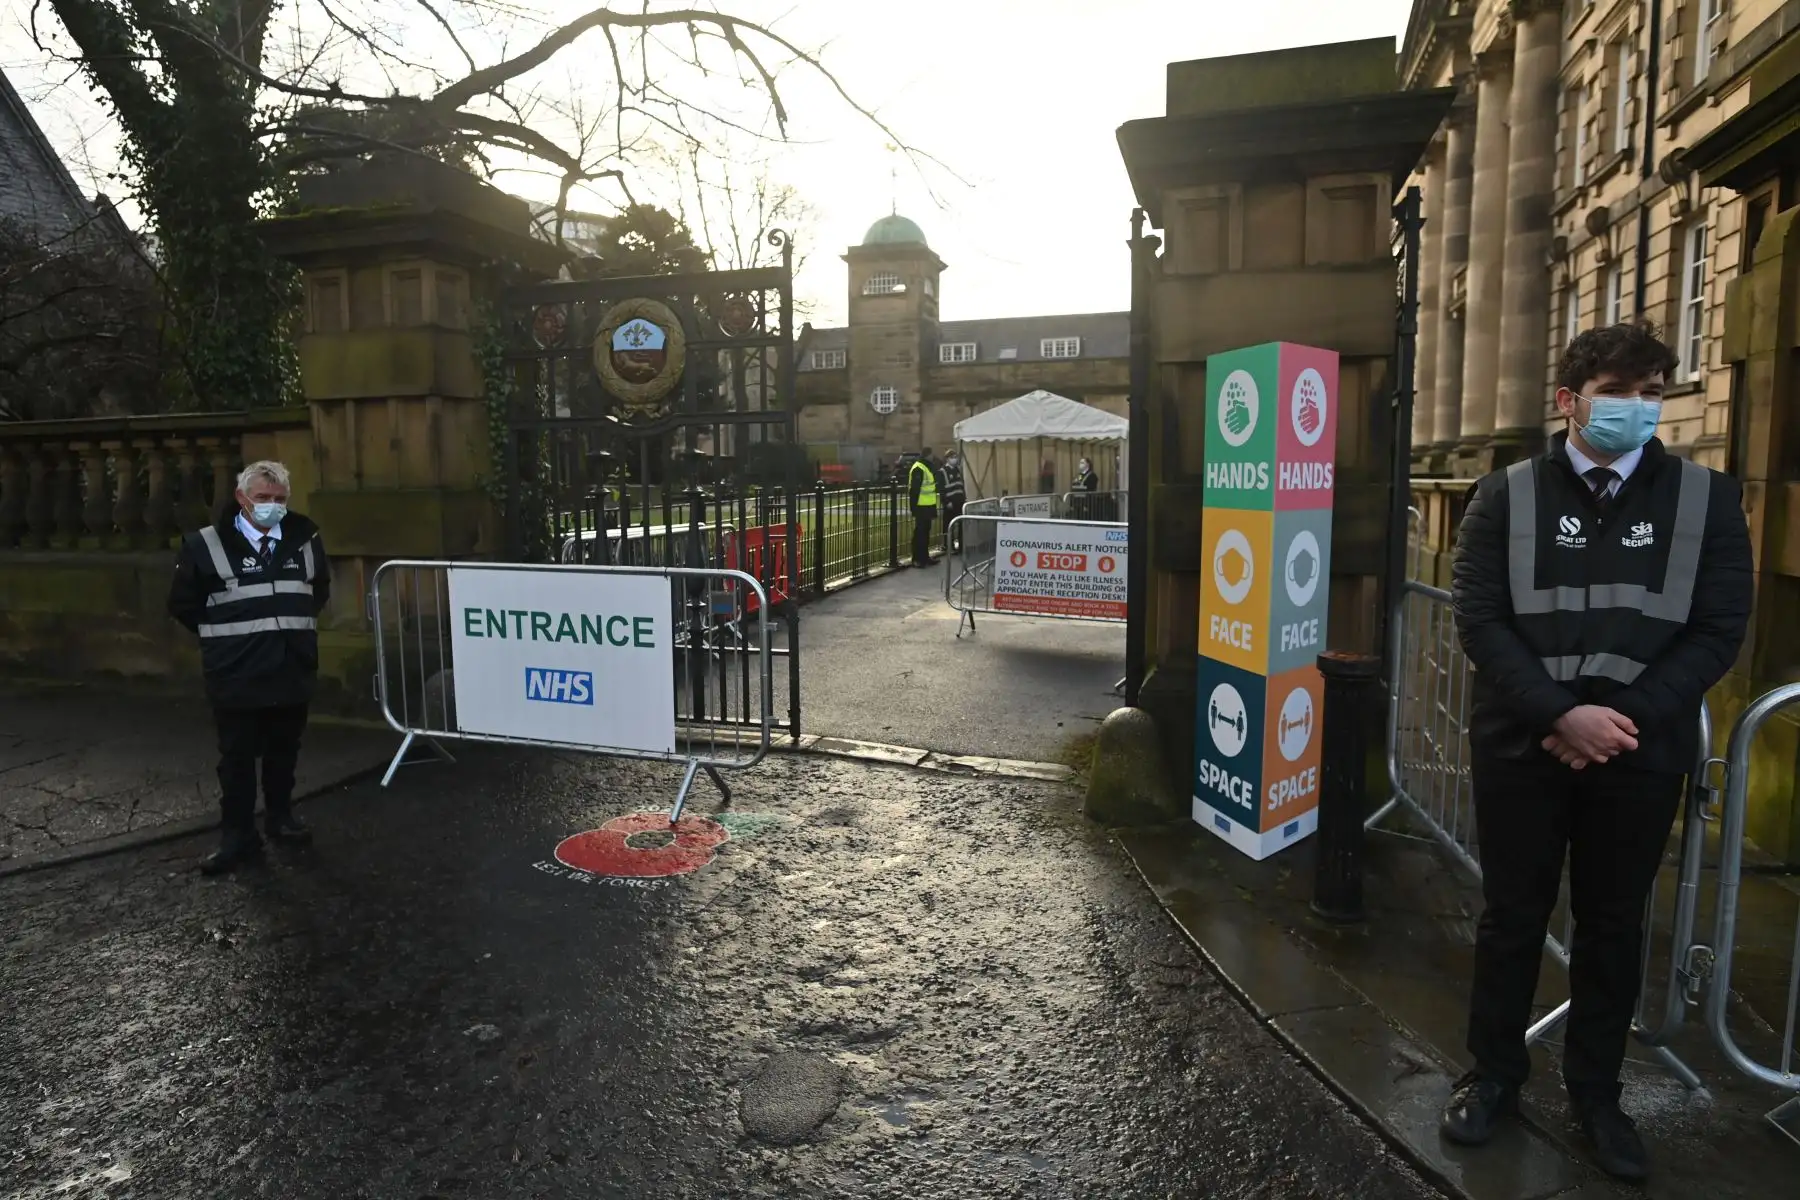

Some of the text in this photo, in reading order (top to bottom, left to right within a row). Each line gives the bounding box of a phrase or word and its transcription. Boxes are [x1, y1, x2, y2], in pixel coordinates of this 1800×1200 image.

[1206, 461, 1270, 491] HANDS
[1278, 461, 1334, 491] HANDS
[1000, 539, 1128, 555] CORONAVIRUS ALERT NOTICE
[1106, 531, 1128, 541] NHS
[1042, 554, 1082, 570] STOP
[997, 577, 1126, 594] DO NOT ENTER THIS BUILDING OR
[1009, 570, 1026, 579] YOU
[1027, 572, 1048, 581] HAVE
[1050, 573, 1056, 581] A
[1058, 573, 1073, 582] FLU
[1075, 574, 1090, 584] LIKE
[1093, 576, 1124, 585] ILLNESS
[997, 585, 1126, 601] APPROACH THE RECEPTION DESK!
[464, 607, 656, 648] ENTRANCE
[1210, 614, 1253, 652] FACE
[1280, 617, 1319, 652] FACE
[527, 670, 590, 703] NHS
[1199, 758, 1253, 811] SPACE
[1267, 766, 1317, 811] SPACE
[568, 871, 597, 884] WE
[597, 877, 671, 892] FORGET
